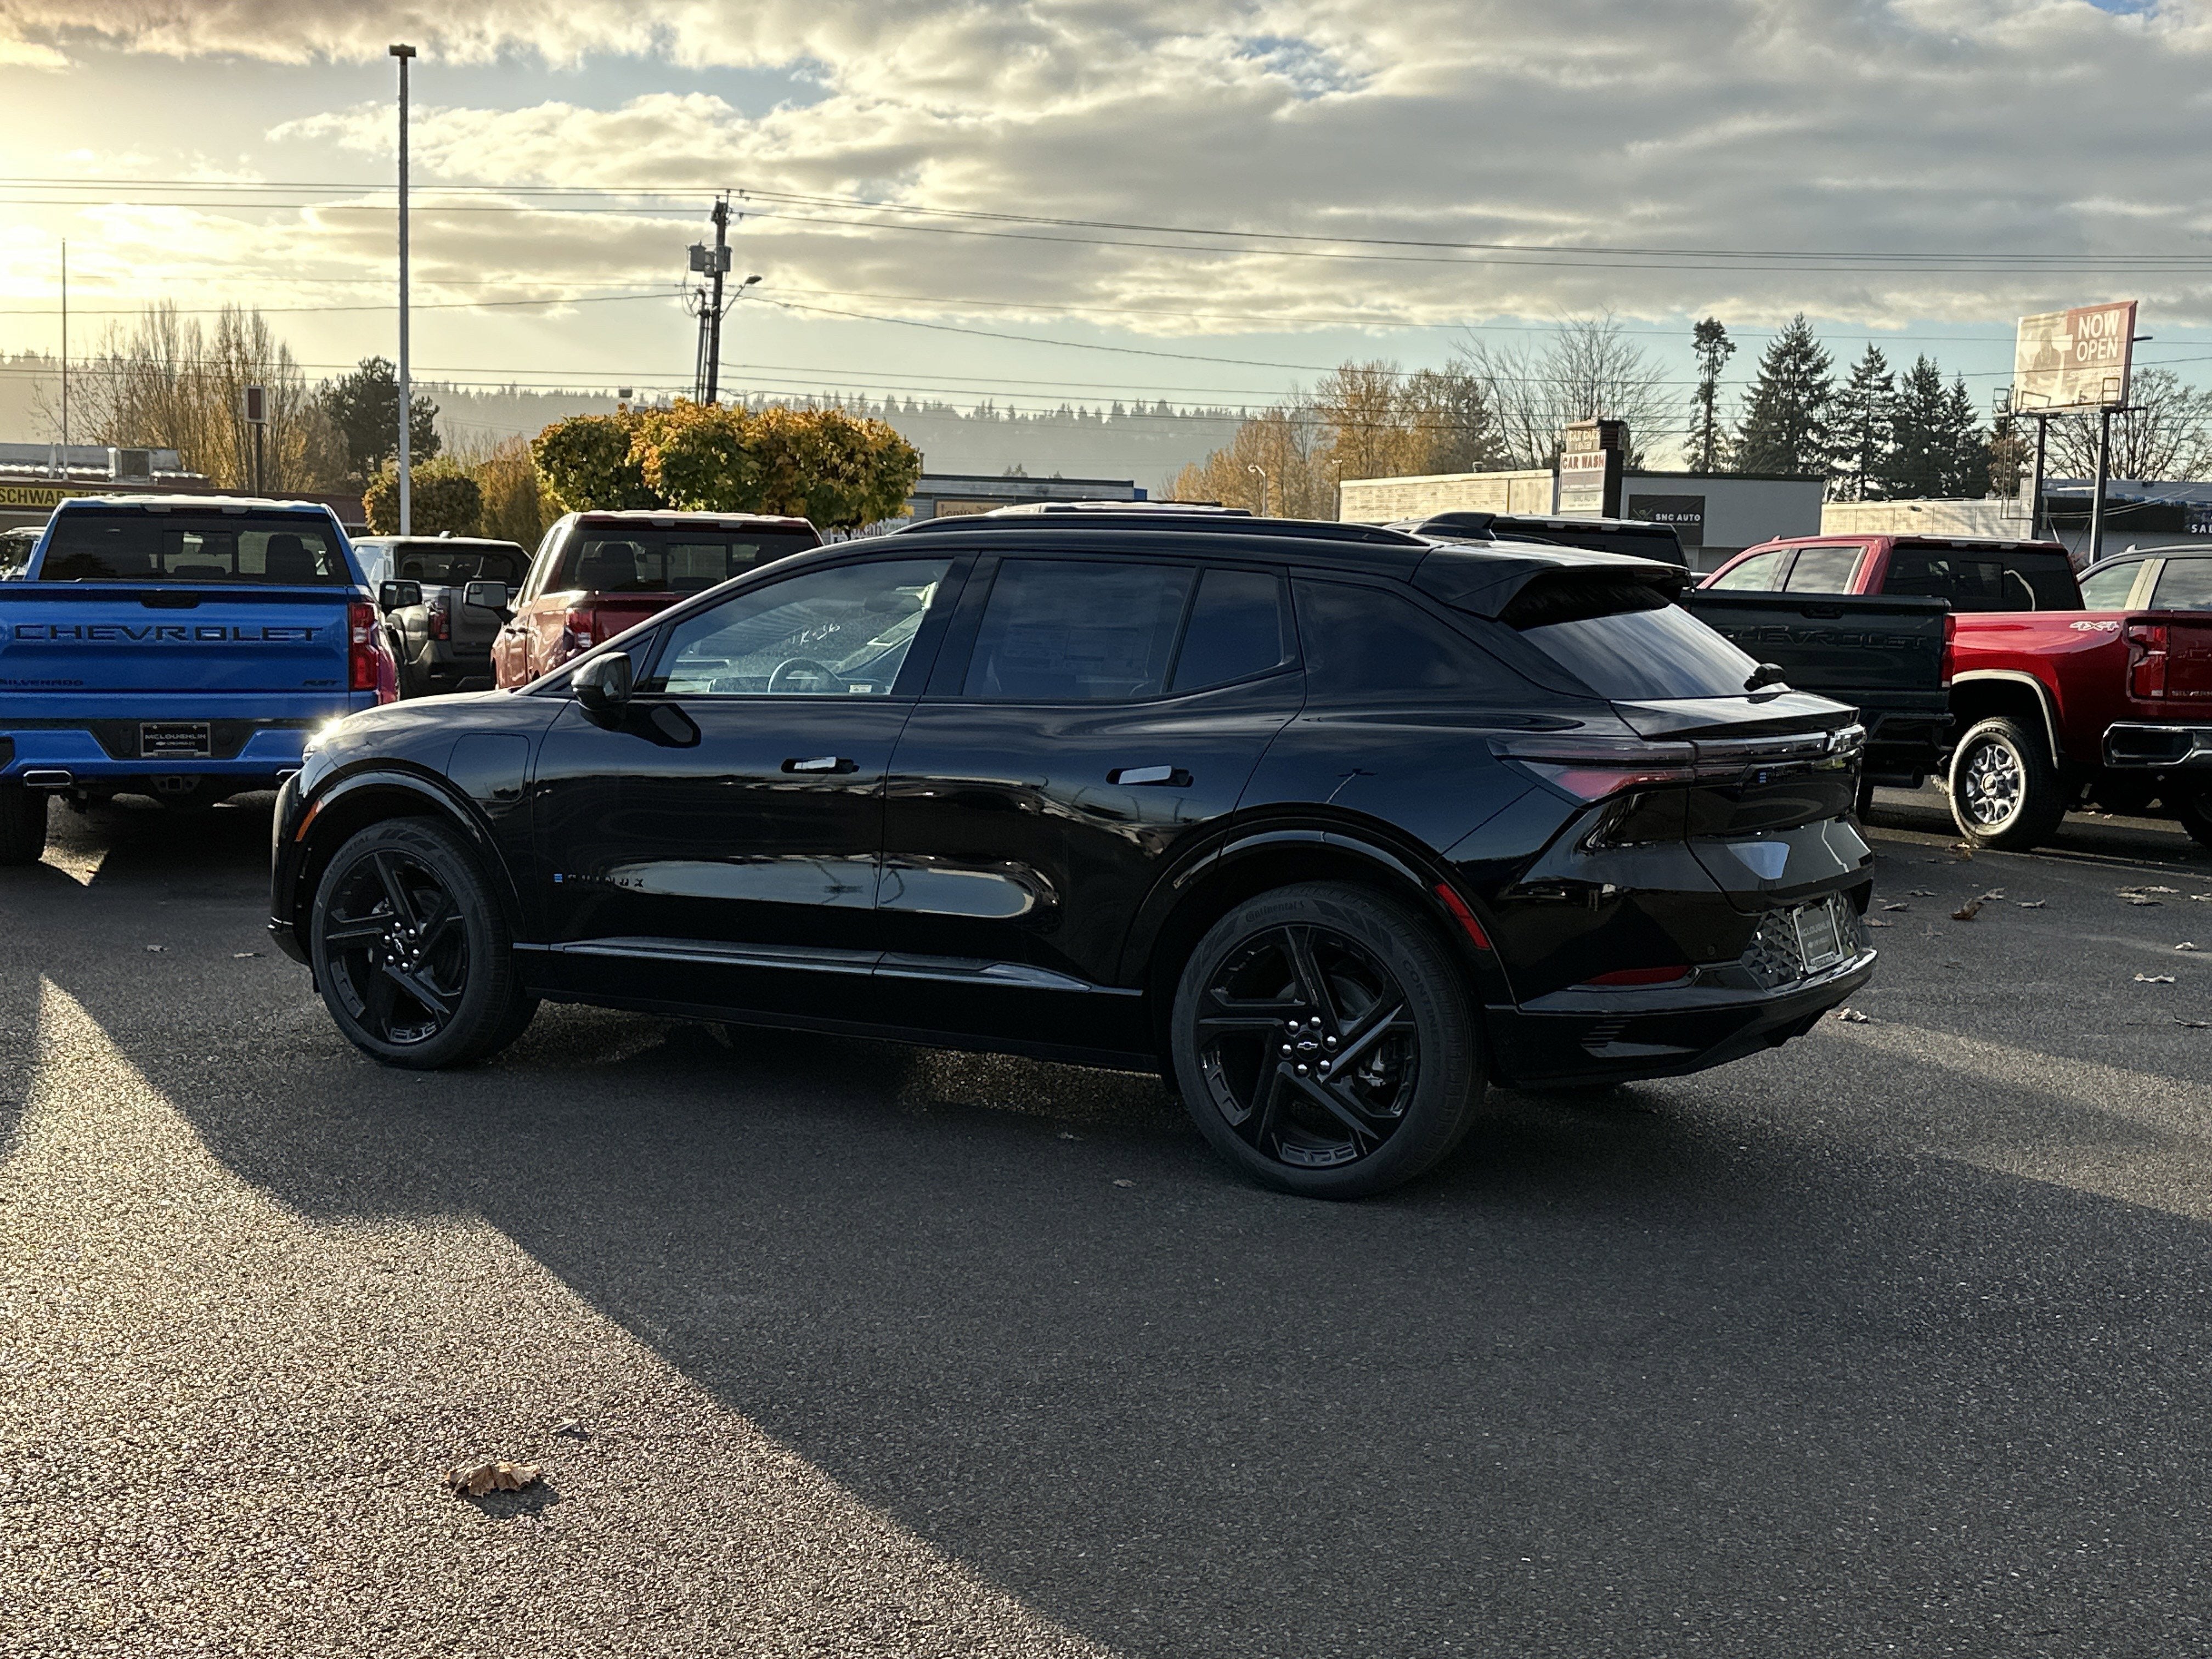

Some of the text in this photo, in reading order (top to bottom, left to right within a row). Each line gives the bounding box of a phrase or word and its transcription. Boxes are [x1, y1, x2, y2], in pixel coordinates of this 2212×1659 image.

[2078, 311, 2120, 340] NOW
[2076, 336, 2119, 362] OPEN
[1562, 455, 1604, 470] CAR WASH
[15, 624, 324, 641] CHEVROLET
